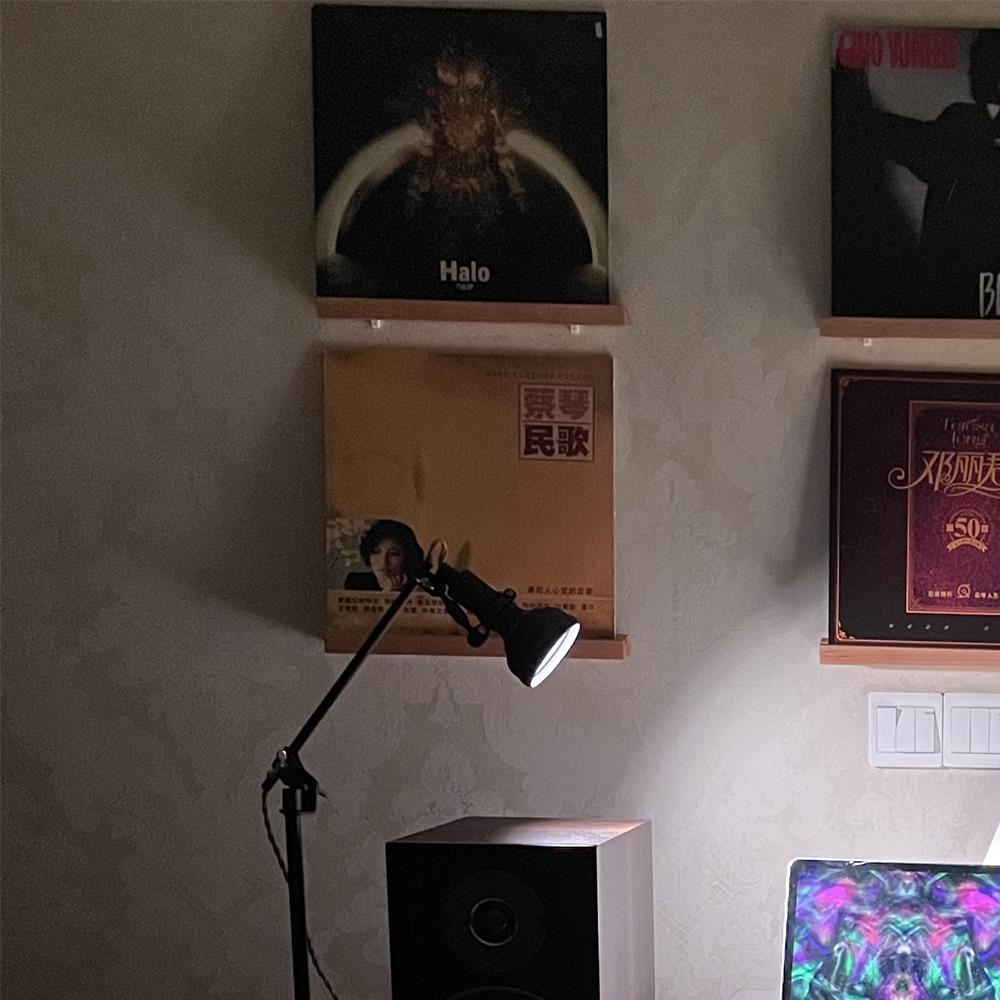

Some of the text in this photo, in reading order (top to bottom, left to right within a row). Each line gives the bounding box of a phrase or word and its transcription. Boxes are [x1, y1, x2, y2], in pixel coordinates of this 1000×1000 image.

[439, 260, 491, 283] Halo
[524, 425, 589, 457] 民歌
[953, 517, 981, 538] 50
